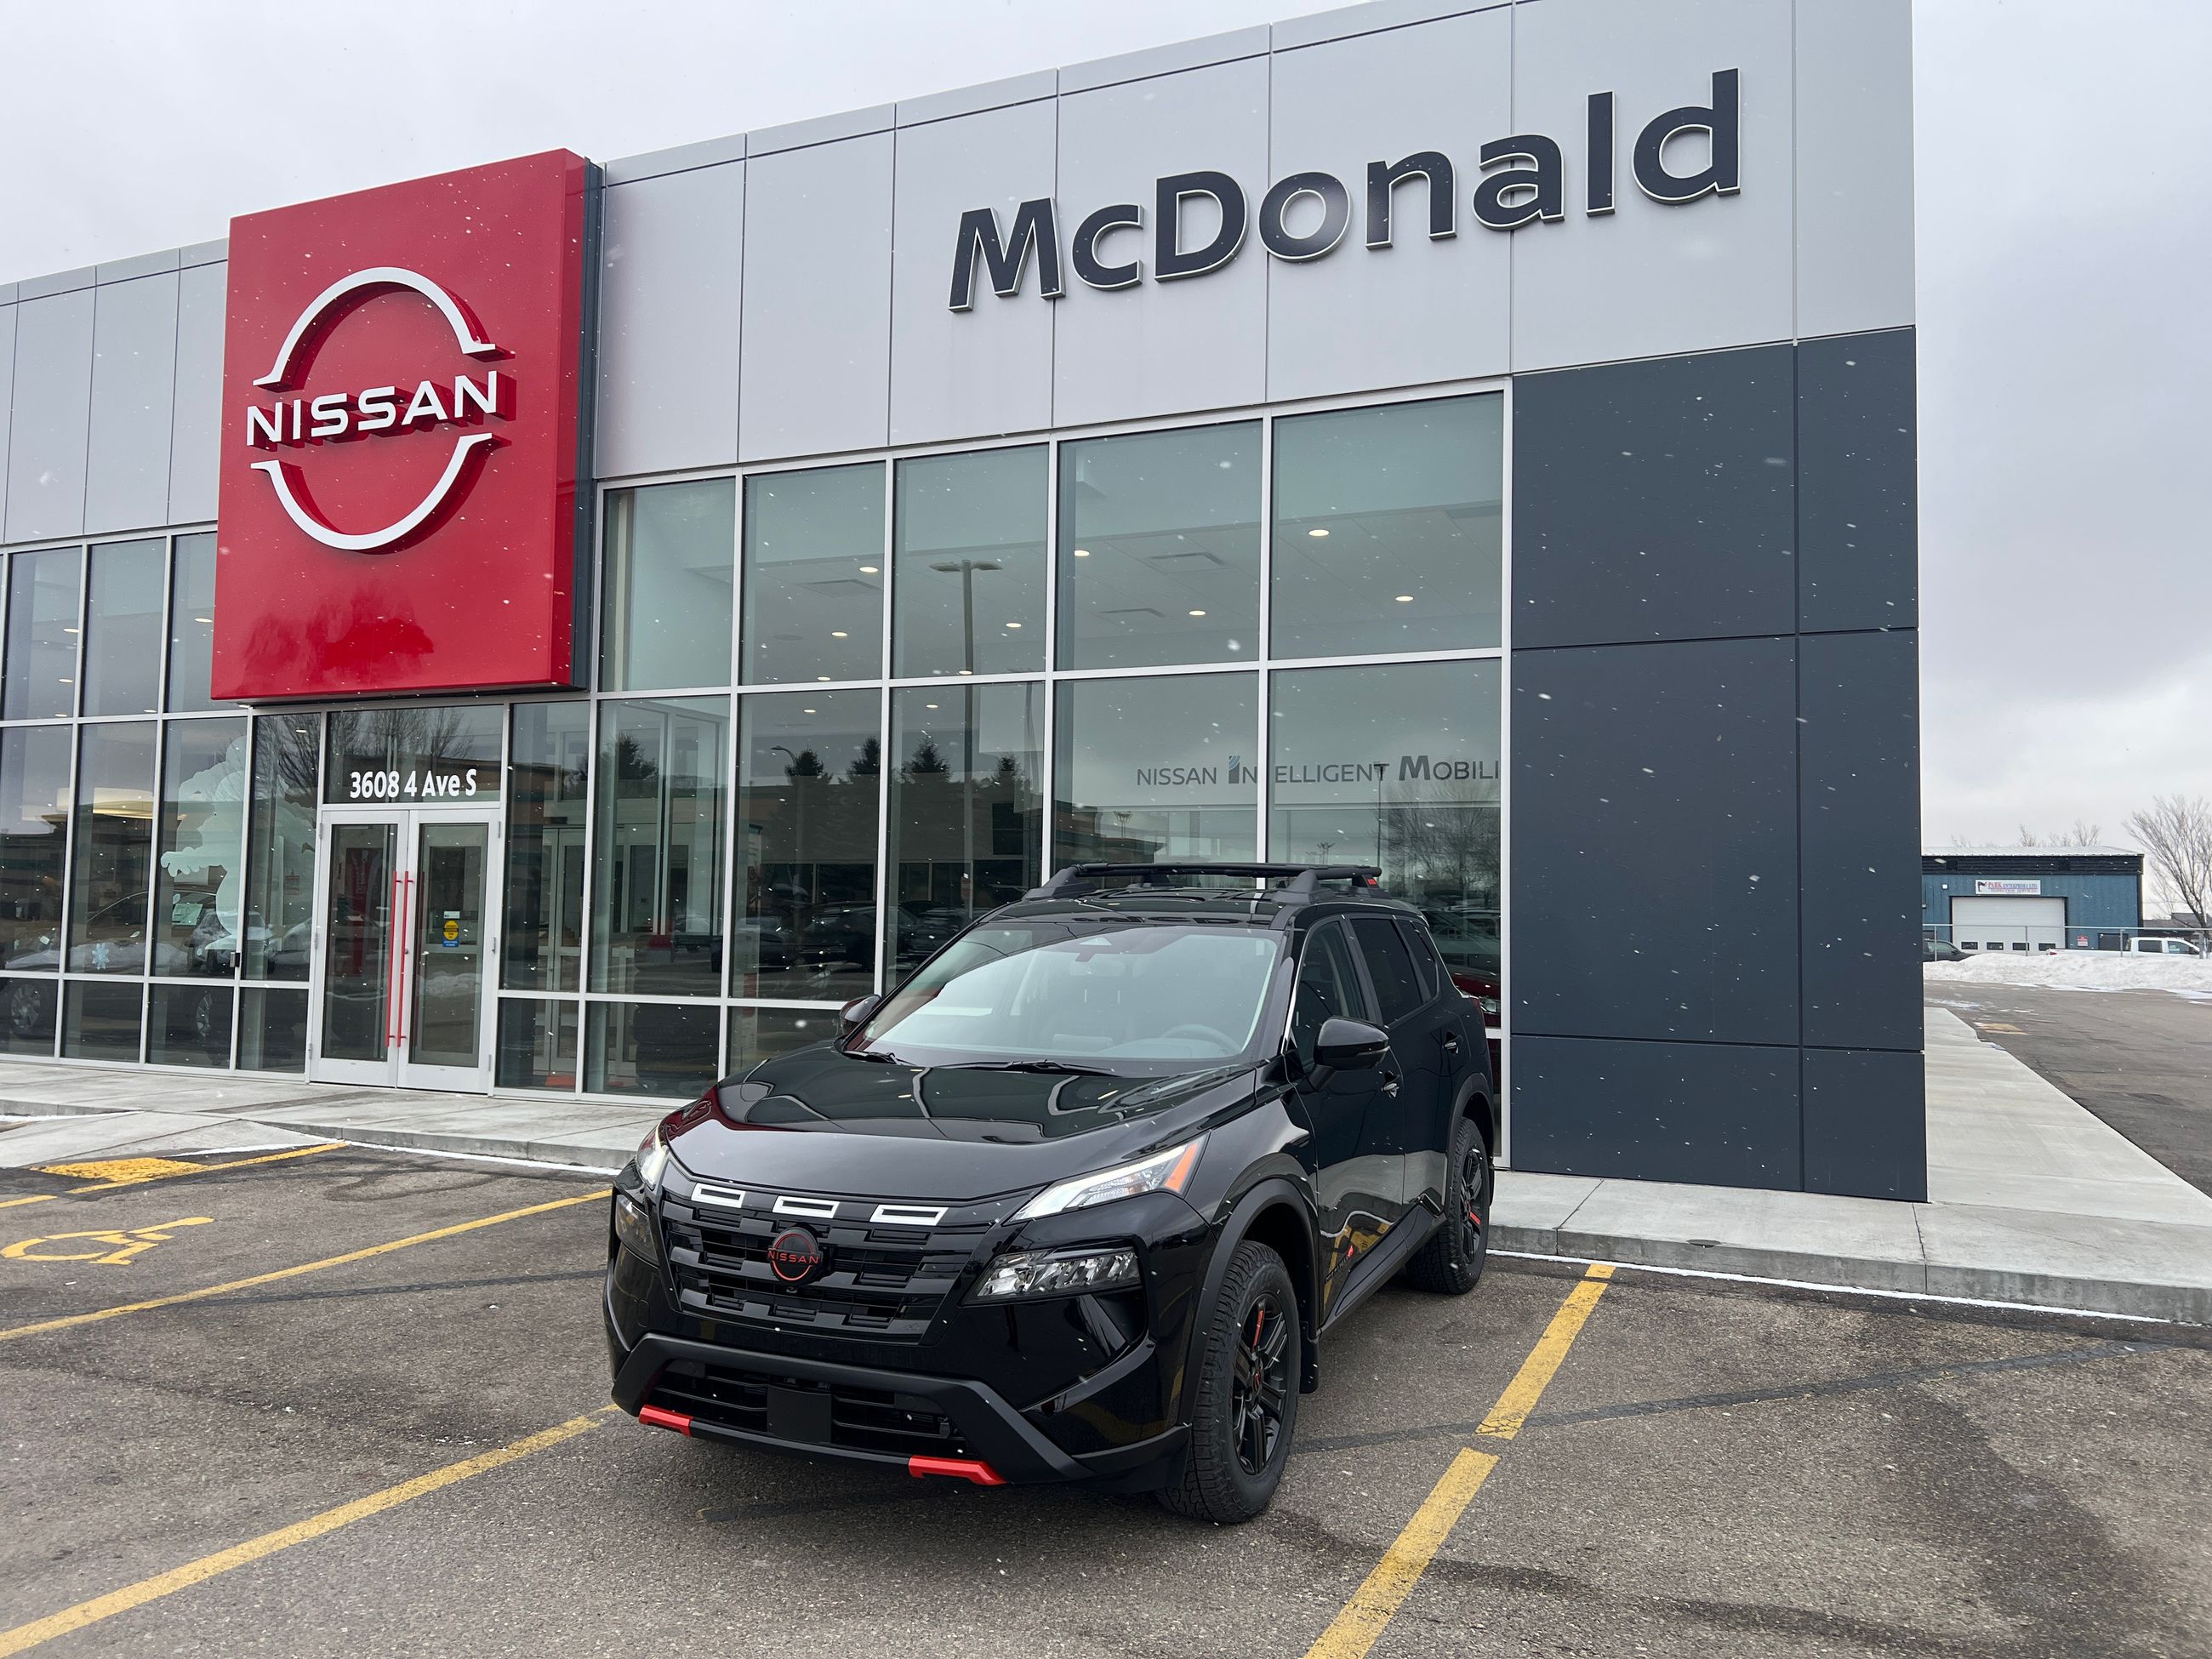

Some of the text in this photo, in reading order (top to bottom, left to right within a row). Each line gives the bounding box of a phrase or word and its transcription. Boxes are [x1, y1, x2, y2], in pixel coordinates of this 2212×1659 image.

[948, 68, 1742, 312] McDonald
[246, 370, 499, 447] NISSAN
[350, 768, 477, 799] 3608 4 Ave S
[1137, 767, 1217, 786] NISSAN
[1228, 755, 1389, 784] INELLIGENT
[767, 1250, 820, 1264] NISSAN
